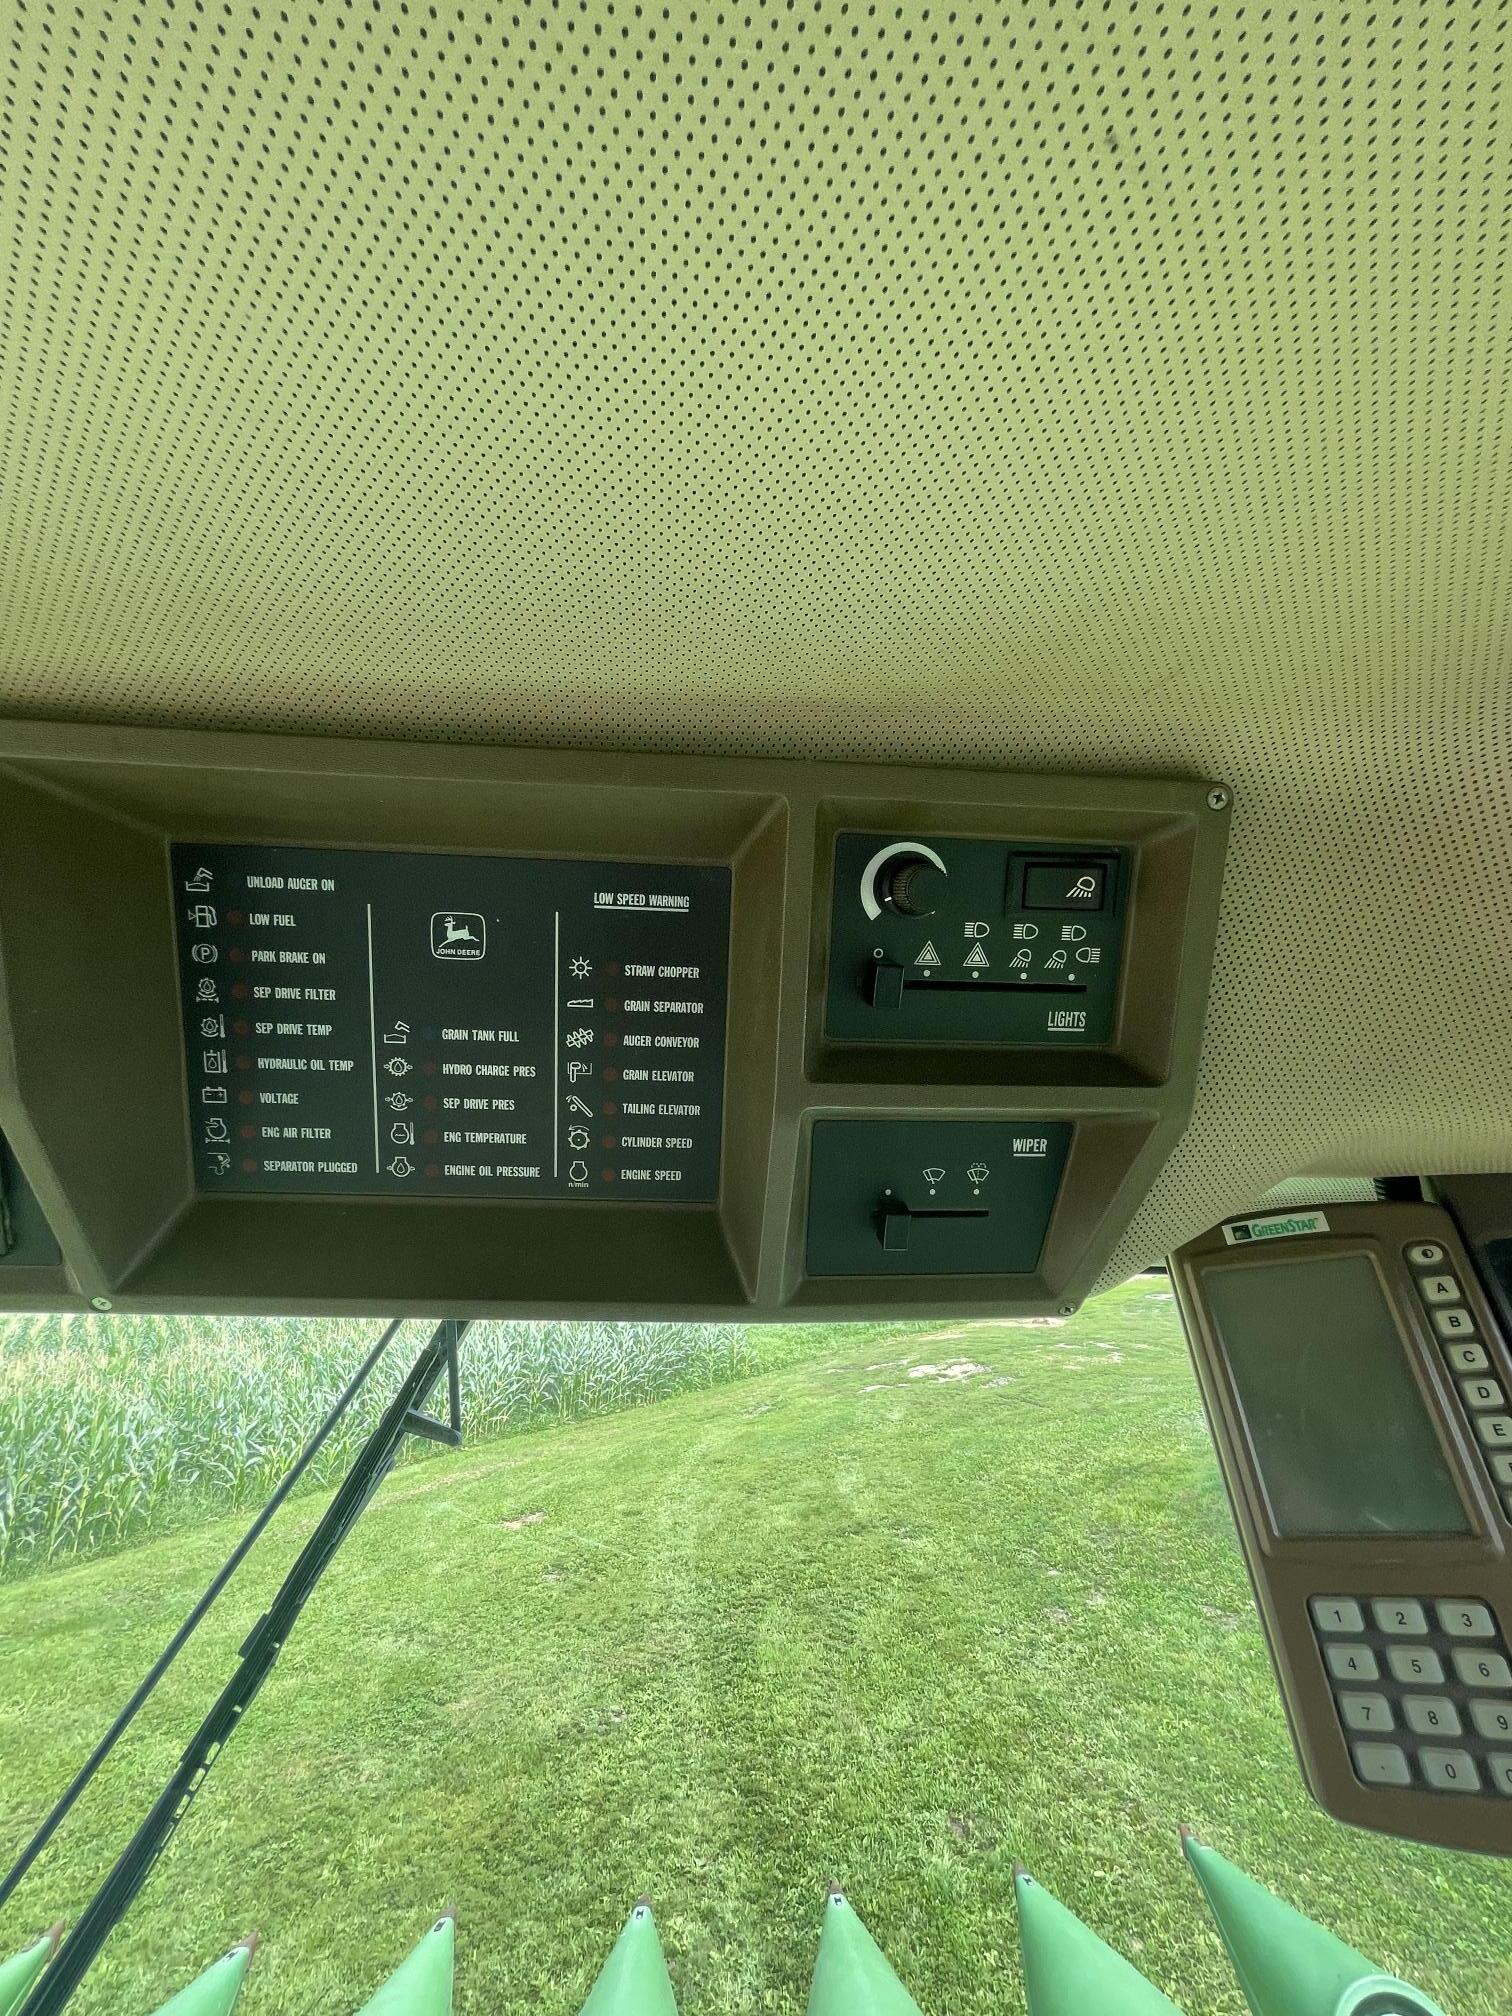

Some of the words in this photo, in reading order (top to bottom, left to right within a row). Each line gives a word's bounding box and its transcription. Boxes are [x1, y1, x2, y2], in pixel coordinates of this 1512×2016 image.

[247, 877, 284, 890] UNLOAD
[288, 878, 318, 891] AUGER
[321, 879, 335, 891] ON
[594, 893, 614, 905] LOW
[617, 894, 646, 906] SPEED
[649, 895, 690, 907] WARNING
[249, 914, 270, 925] LOW
[274, 915, 296, 926] FUEL
[252, 951, 276, 963] PARK
[279, 952, 308, 964] BRAKE
[312, 953, 326, 964] ON
[625, 965, 655, 976] STRAW
[658, 966, 699, 978] CHOPPER
[253, 987, 271, 999] SEP
[275, 988, 301, 999] DRIVE
[305, 989, 336, 1001] FILTER
[624, 1000, 650, 1012] GRAIN
[653, 1002, 704, 1013] SEPARATOR
[1048, 1011, 1087, 1027] LIGHTS
[256, 1023, 273, 1034] SEP
[277, 1024, 303, 1035] DRIVE
[307, 1024, 332, 1036] TEMP
[442, 1029, 468, 1040] GRAIN
[472, 1030, 495, 1041] TANK
[498, 1031, 519, 1042] FULL
[623, 1036, 652, 1047] AUGER
[655, 1037, 699, 1048] CONVEYOR
[258, 1058, 307, 1071] HYDRAULIC
[310, 1059, 326, 1071] OIL
[329, 1060, 354, 1072] TEMP
[442, 1064, 472, 1076] HYDRO
[476, 1065, 510, 1076] CHARGE
[513, 1066, 536, 1077] PRES
[623, 1070, 648, 1081] GRAIN
[652, 1071, 694, 1082] ELEVATOR
[260, 1093, 299, 1104] VOLTAGE
[444, 1098, 460, 1109] SEP
[464, 1099, 488, 1110] DRIVE
[492, 1100, 515, 1111] PRES
[622, 1104, 655, 1114] TAILING
[658, 1105, 700, 1115] ELEVATOR
[262, 1127, 280, 1138] ENG
[283, 1127, 298, 1138] AIR
[301, 1128, 331, 1139] FILTER
[444, 1132, 462, 1143] ENG
[464, 1132, 527, 1144] TEMPERATURE
[621, 1137, 662, 1147] CYLINDER
[665, 1138, 692, 1148] SPEED
[1013, 1139, 1047, 1152] WIPER
[263, 1161, 315, 1172] SEPARATOR
[318, 1161, 358, 1173] PLUGGED
[445, 1165, 476, 1176] ENGINE
[479, 1166, 493, 1176] OIL
[496, 1166, 540, 1178] PRESSURE
[621, 1170, 651, 1180] ENGINE
[654, 1171, 682, 1180] SPEED
[1437, 1282, 1448, 1294] A
[1448, 1316, 1461, 1328] B
[1463, 1350, 1475, 1363] C
[1477, 1386, 1490, 1399] D
[1492, 1423, 1506, 1437] E
[1334, 1610, 1341, 1623] 1
[1395, 1611, 1407, 1625] 2
[1461, 1613, 1472, 1627] 3
[1348, 1657, 1357, 1671] 4
[1411, 1660, 1422, 1673] 5
[1478, 1663, 1490, 1677] 6
[1361, 1707, 1371, 1720] 7
[1427, 1711, 1439, 1725] 8
[1497, 1715, 1508, 1730] 9
[1445, 1763, 1457, 1779] 0
